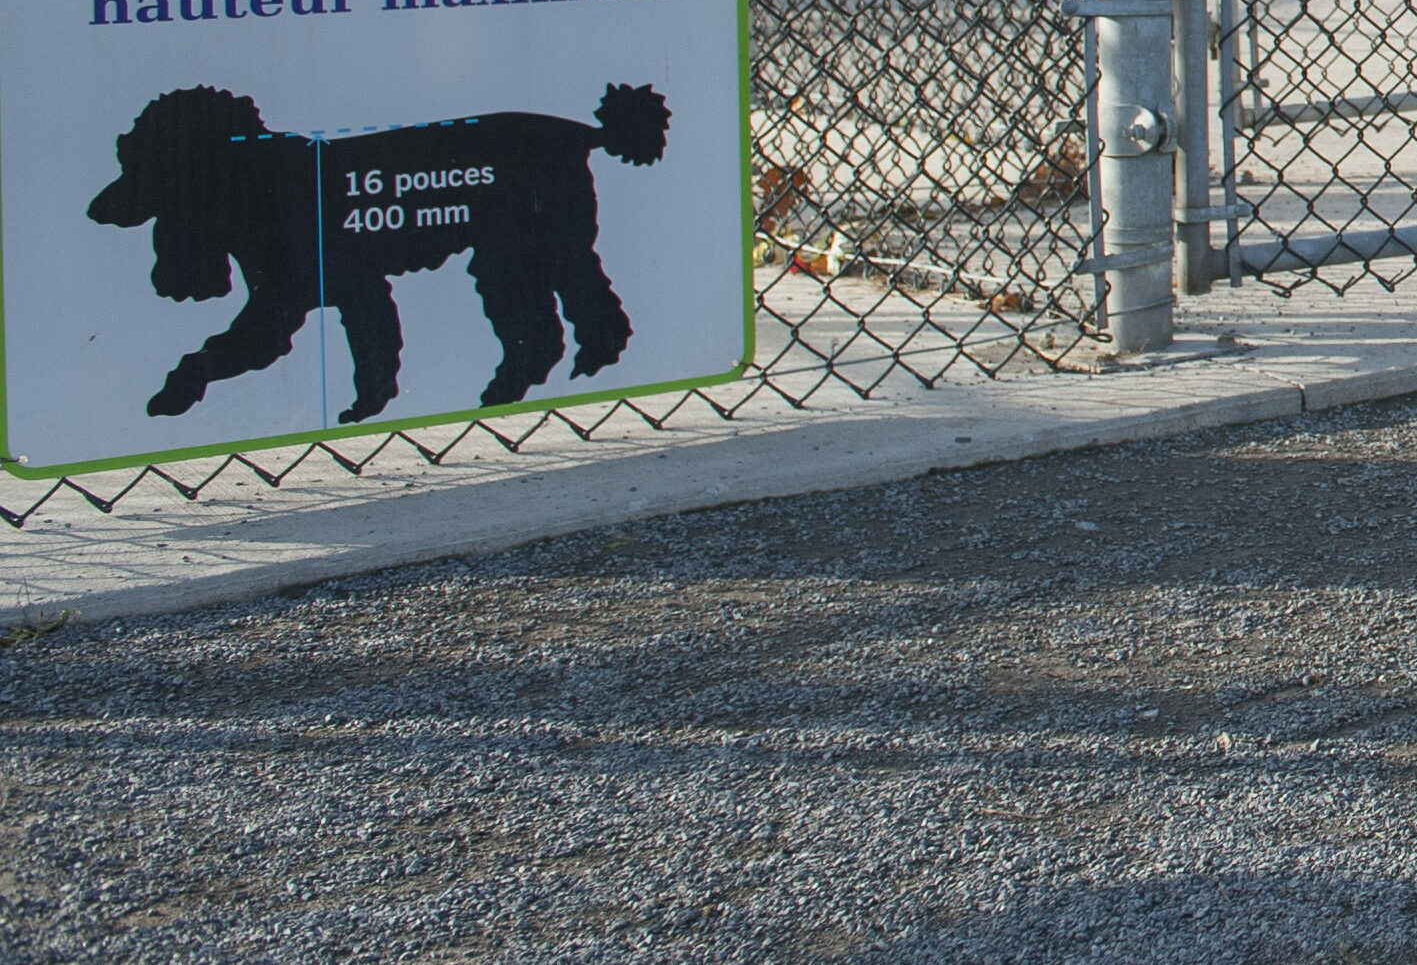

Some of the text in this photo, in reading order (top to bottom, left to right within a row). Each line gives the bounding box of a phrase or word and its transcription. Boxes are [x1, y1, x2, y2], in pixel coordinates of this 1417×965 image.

[345, 166, 495, 198] 16 pouces
[343, 204, 470, 233] 400 mm
